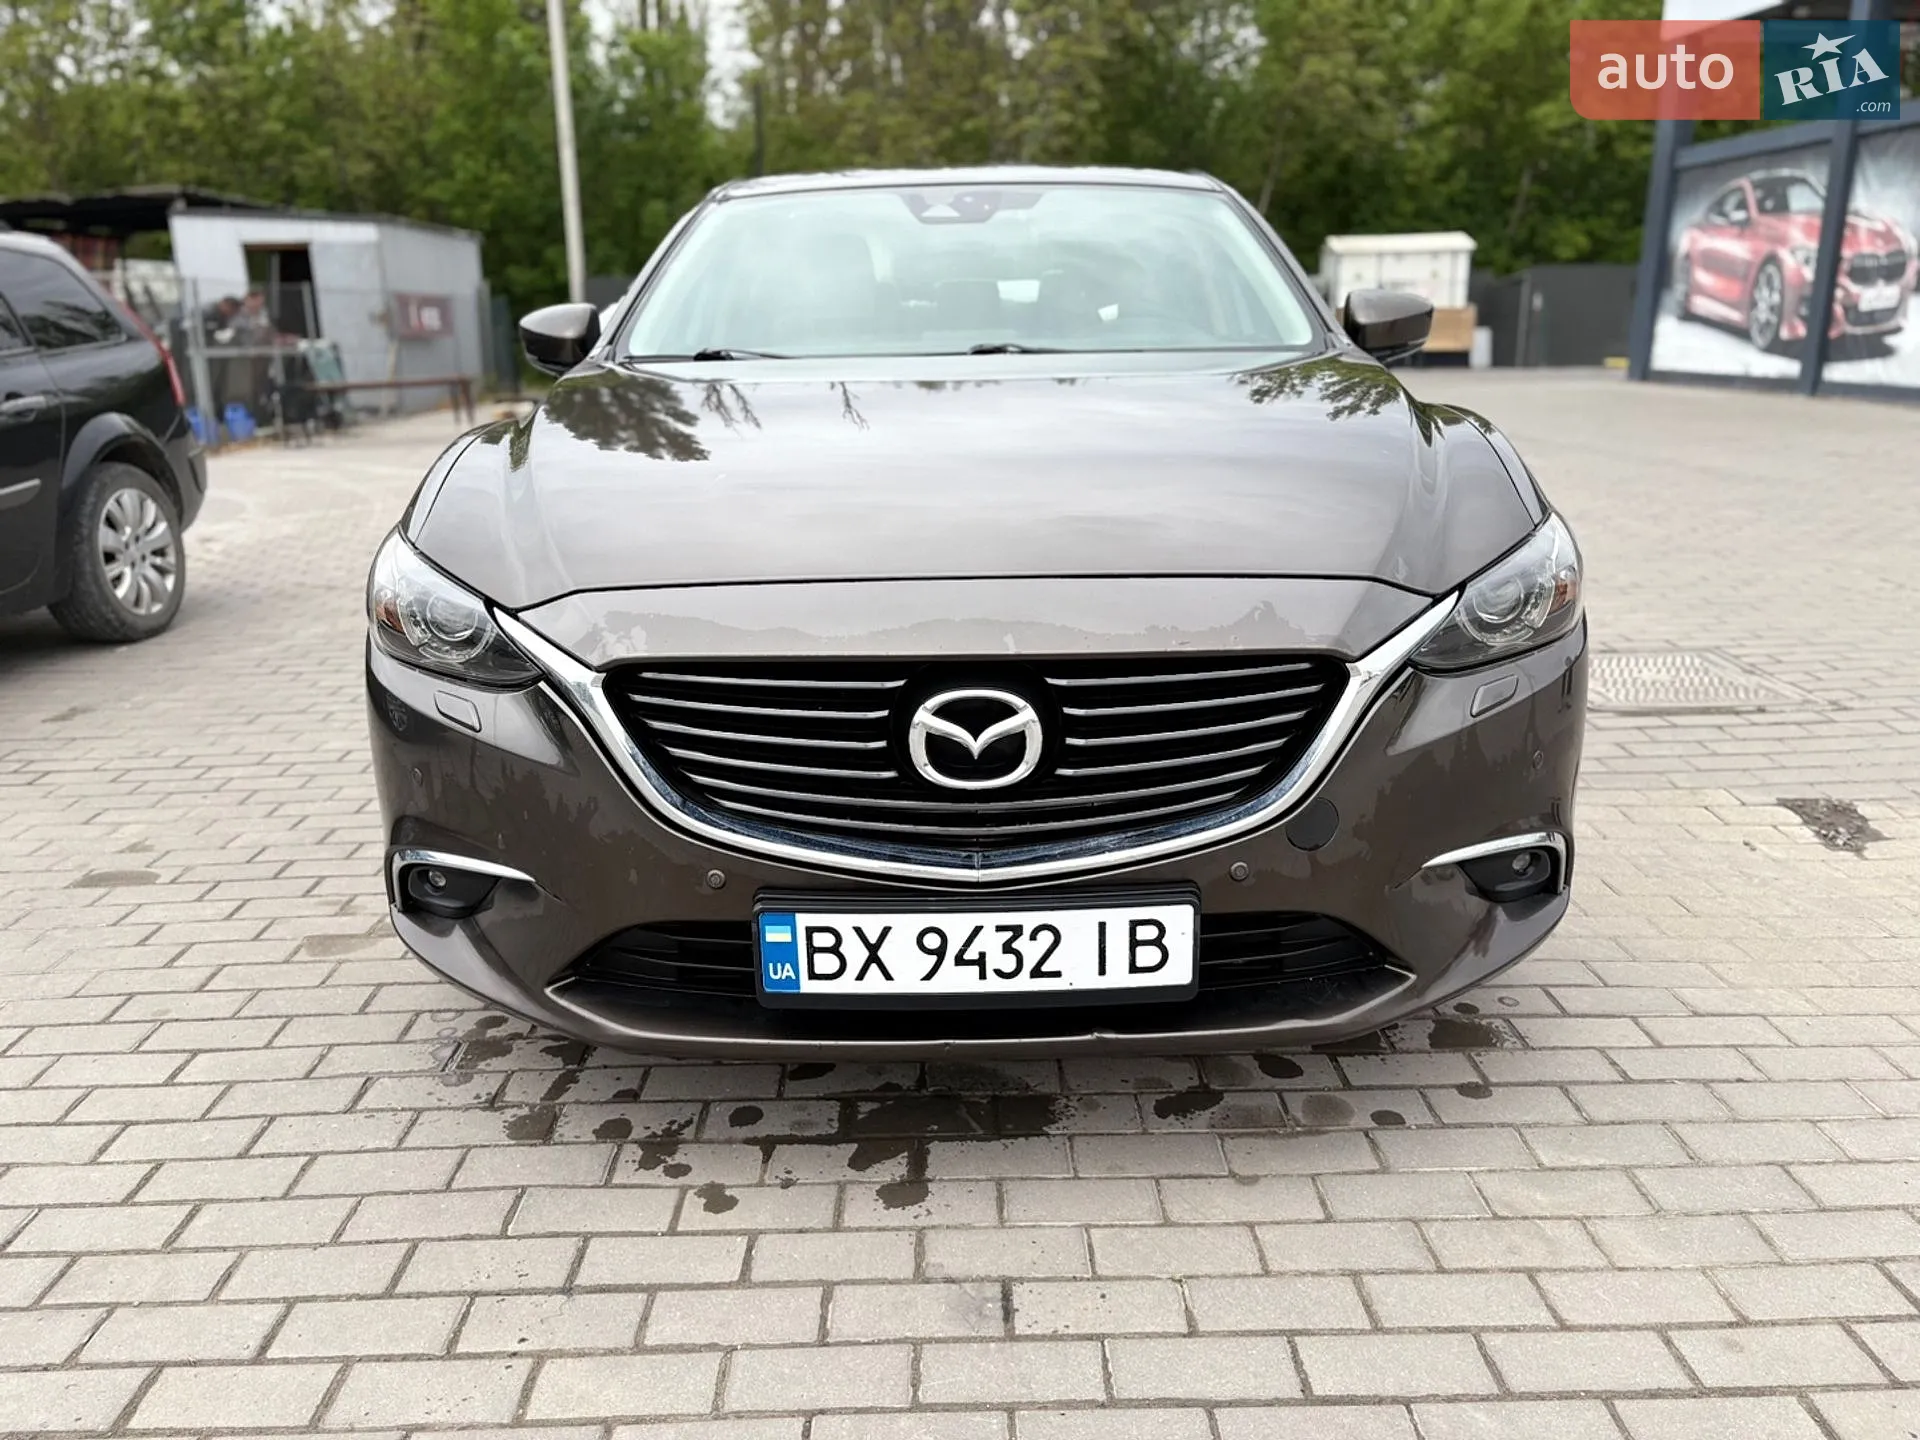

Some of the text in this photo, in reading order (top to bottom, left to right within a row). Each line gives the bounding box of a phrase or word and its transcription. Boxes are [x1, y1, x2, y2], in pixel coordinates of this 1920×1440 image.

[805, 918, 1169, 982] BX 9432 IB
[768, 962, 796, 980] UA
